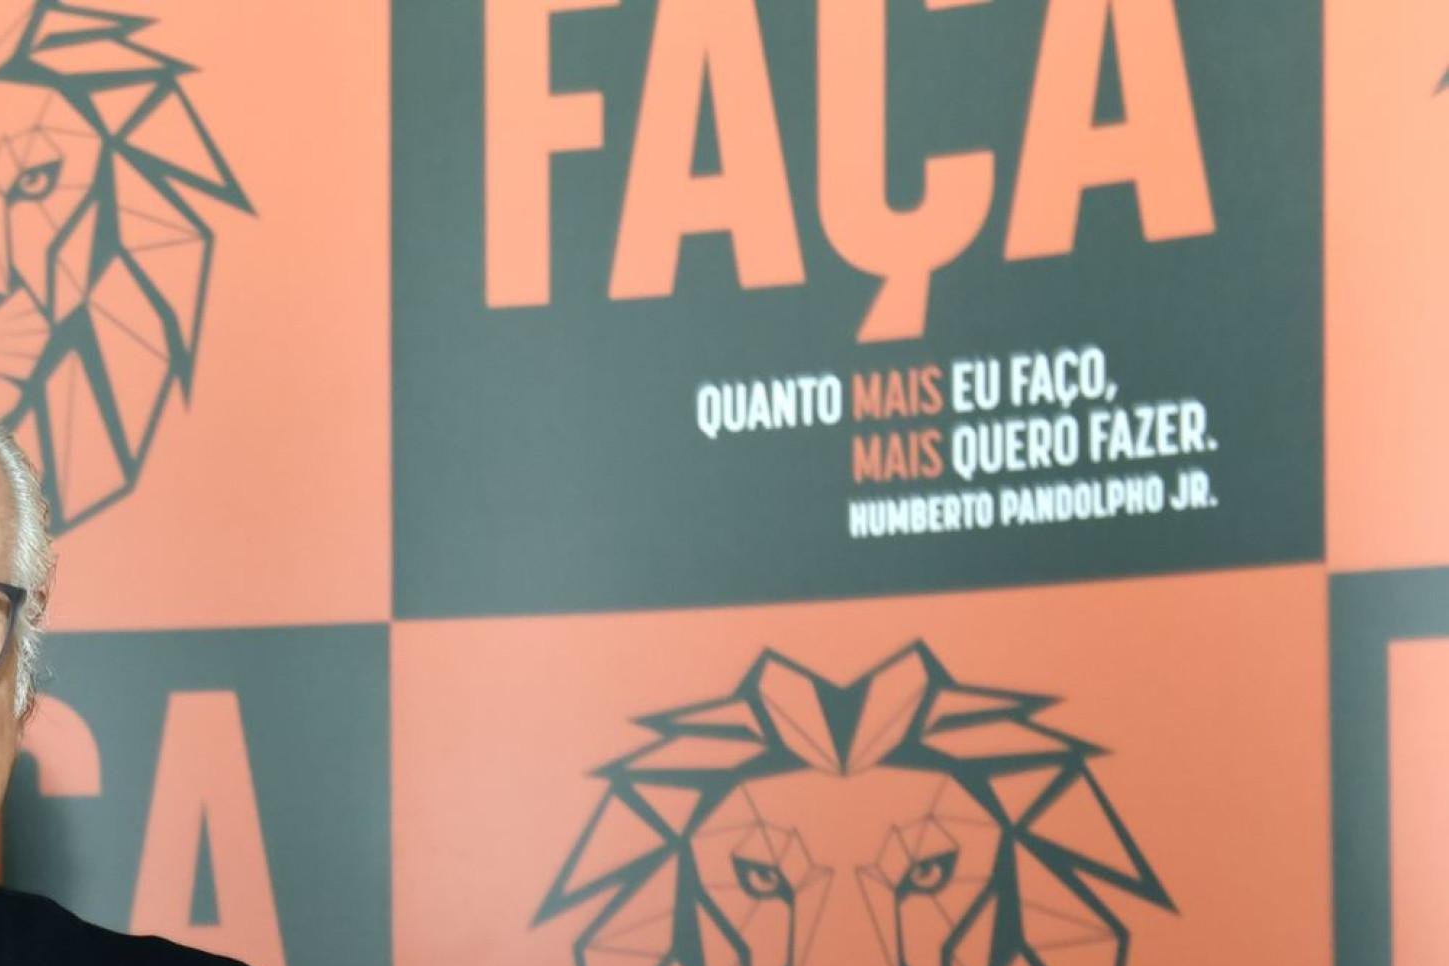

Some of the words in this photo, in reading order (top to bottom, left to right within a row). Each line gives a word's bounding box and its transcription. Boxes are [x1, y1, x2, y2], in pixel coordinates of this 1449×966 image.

[484, 0, 1216, 343] FAÇA
[695, 375, 843, 438] QUANTO
[852, 365, 943, 420] MAIS
[952, 358, 1001, 412] EU
[1010, 346, 1118, 409] FAÇO,
[852, 428, 943, 483] MAIS
[952, 415, 1080, 480] QUERO
[1089, 400, 1218, 463] FAZER.
[850, 495, 995, 539] HUMBERTO
[1001, 476, 1164, 526] PANDOLPHO
[1170, 471, 1218, 511] JR.
